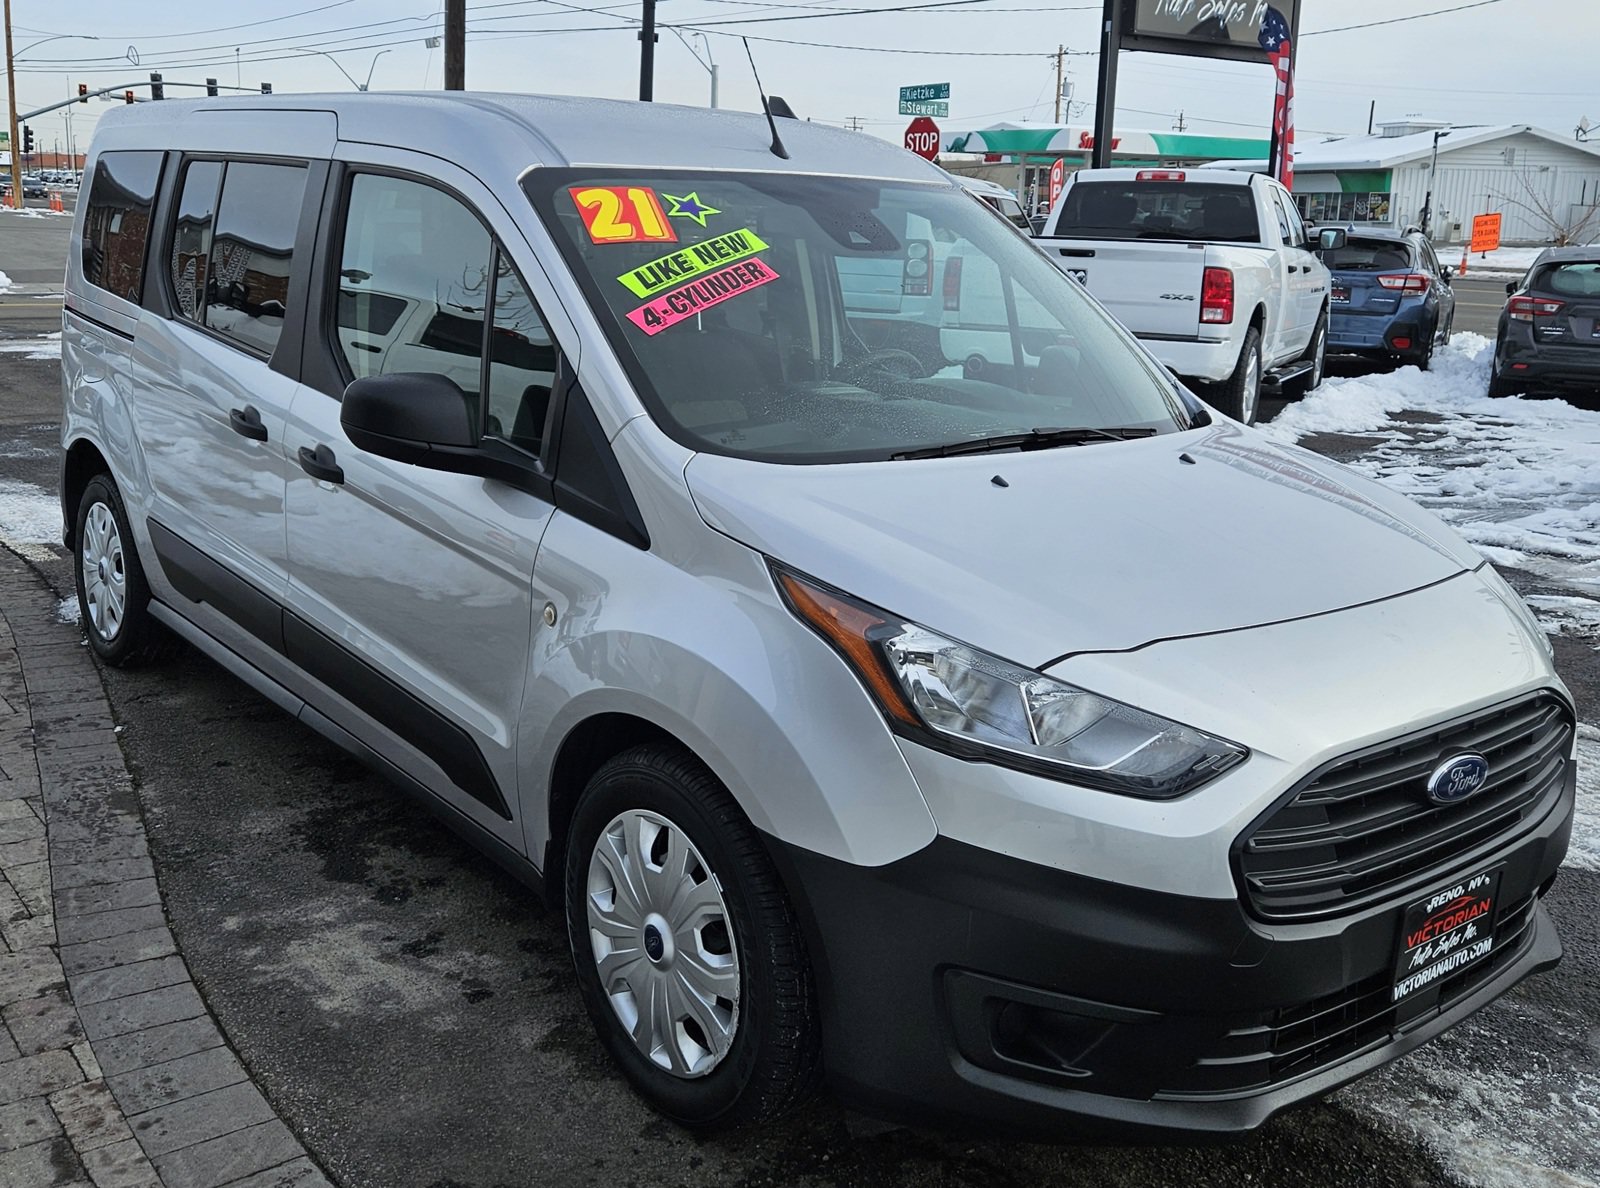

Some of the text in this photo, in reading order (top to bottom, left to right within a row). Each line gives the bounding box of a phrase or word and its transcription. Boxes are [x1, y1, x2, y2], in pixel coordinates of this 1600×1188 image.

[906, 86, 935, 100] Kietzke
[906, 101, 938, 115] Stewart
[906, 131, 938, 152] STOP
[576, 188, 668, 239] 21
[633, 232, 752, 290] LIKE NEW
[643, 261, 769, 328] 4-CYLINDER
[1448, 764, 1479, 795] Ford
[1430, 874, 1486, 908] RENO, NV
[1407, 898, 1490, 948] VICTORIAN
[1394, 938, 1492, 1000] VICTORIANAUTO.COM
[1408, 943, 1433, 970] Auto
[1432, 931, 1462, 958] Sales
